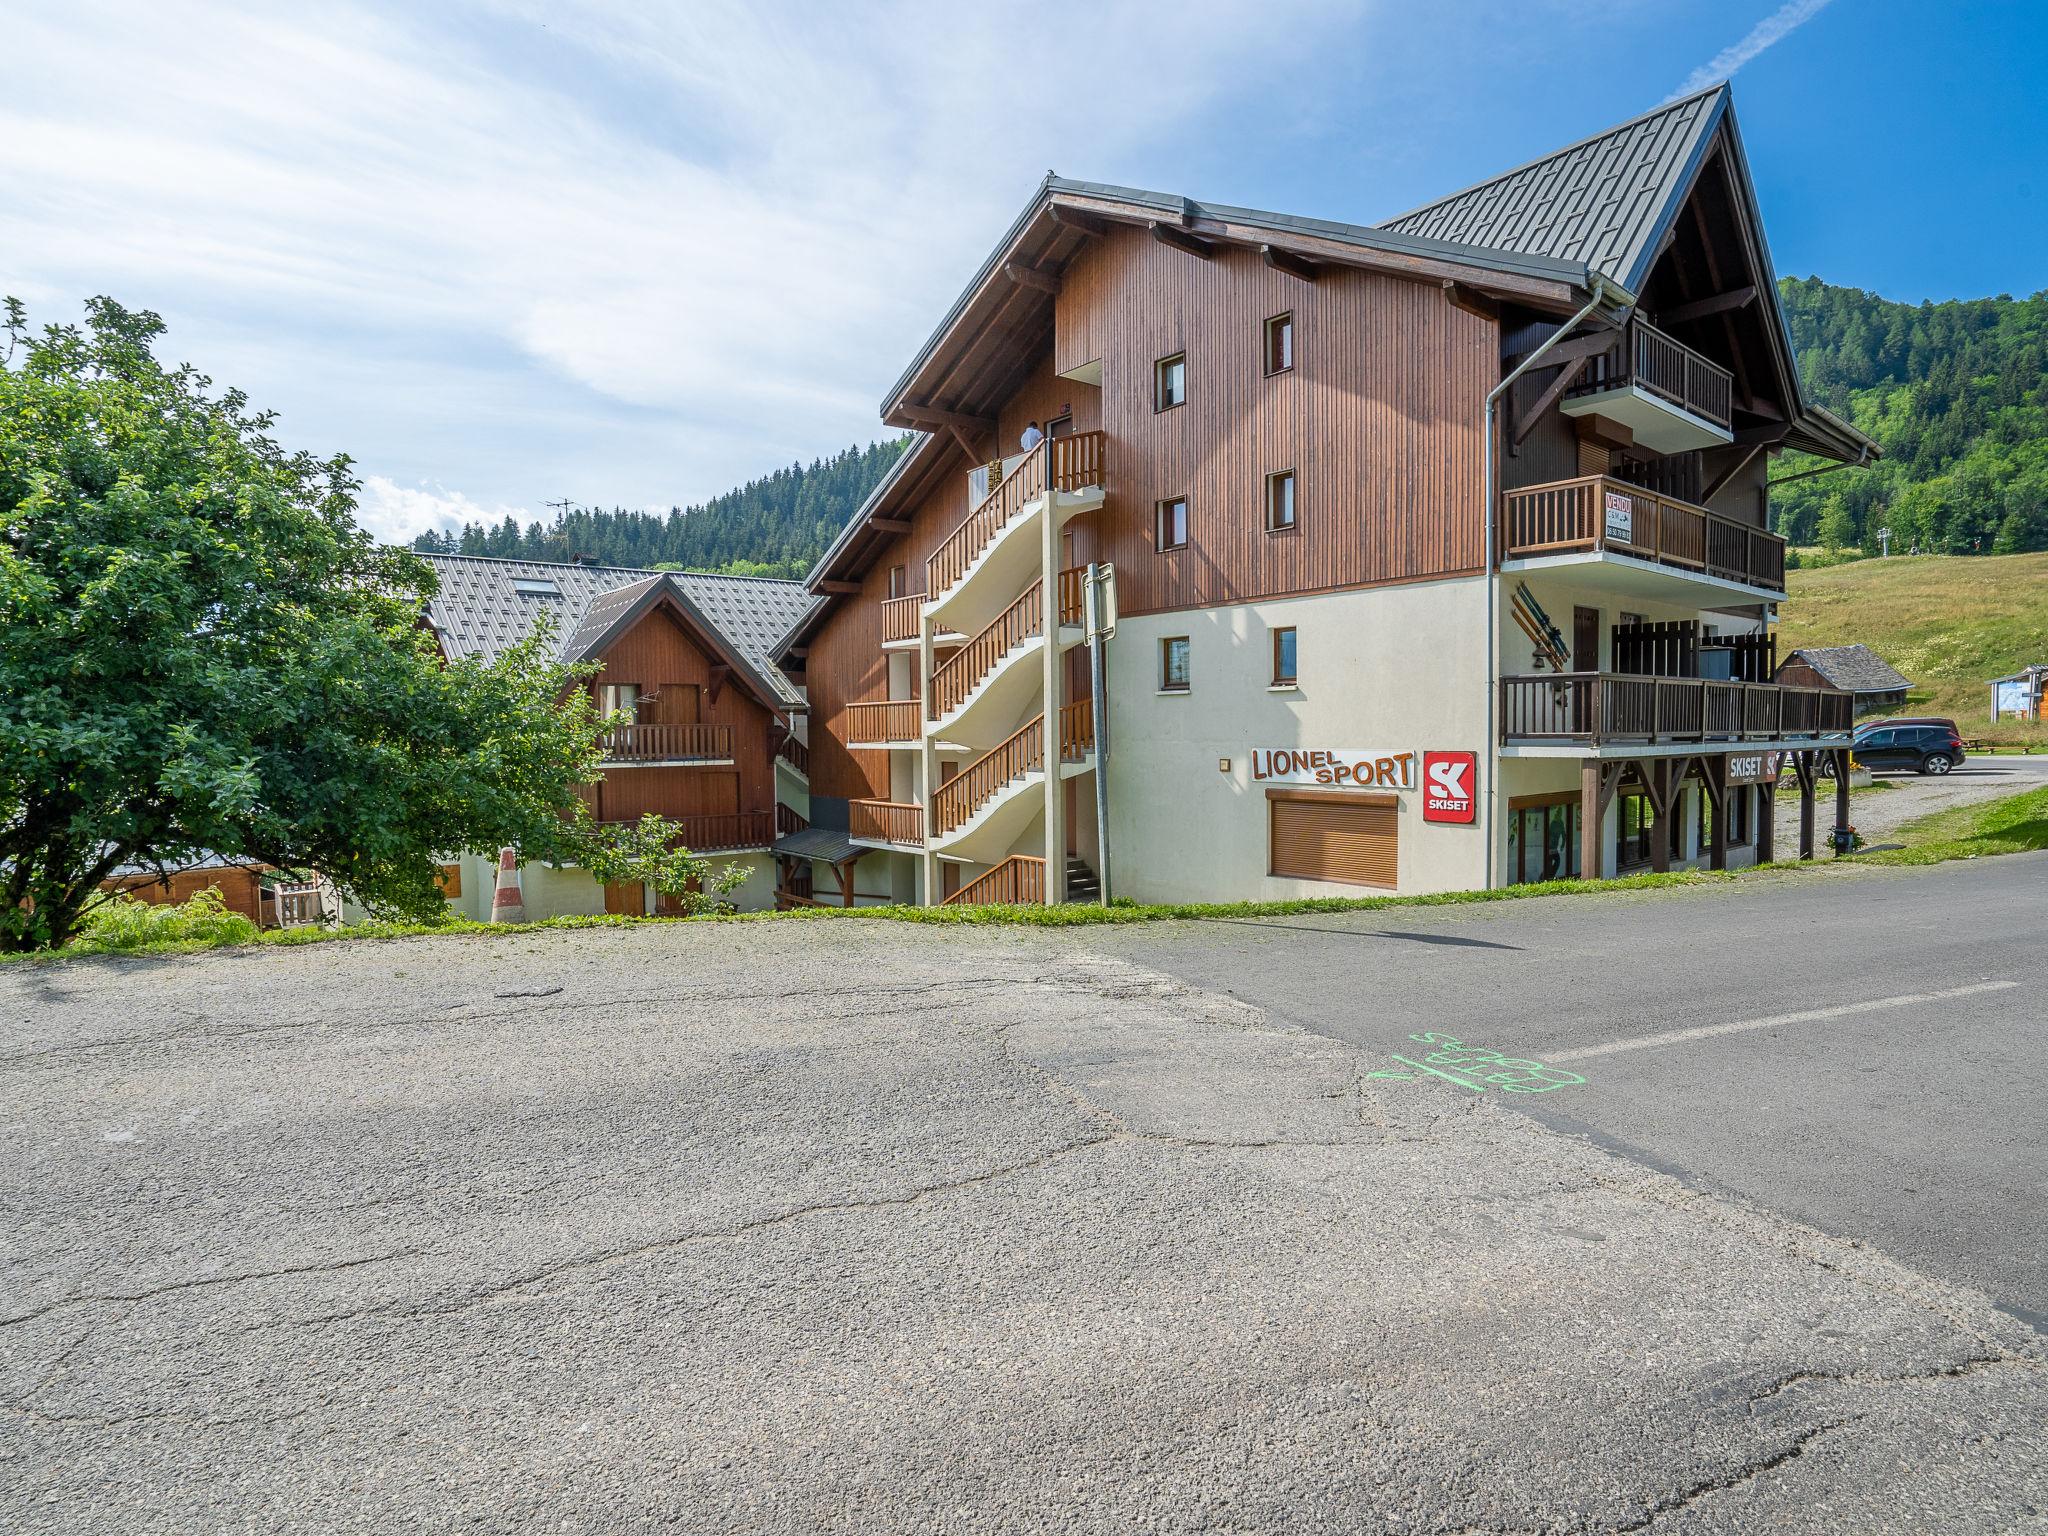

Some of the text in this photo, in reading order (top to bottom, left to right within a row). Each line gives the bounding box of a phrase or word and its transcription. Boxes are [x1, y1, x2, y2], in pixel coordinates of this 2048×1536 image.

[1607, 496, 1631, 513] VENDU
[1252, 750, 1413, 785] LIONEL SPORT
[1731, 756, 1762, 777] SKISET
[1429, 799, 1468, 811] SKISET
